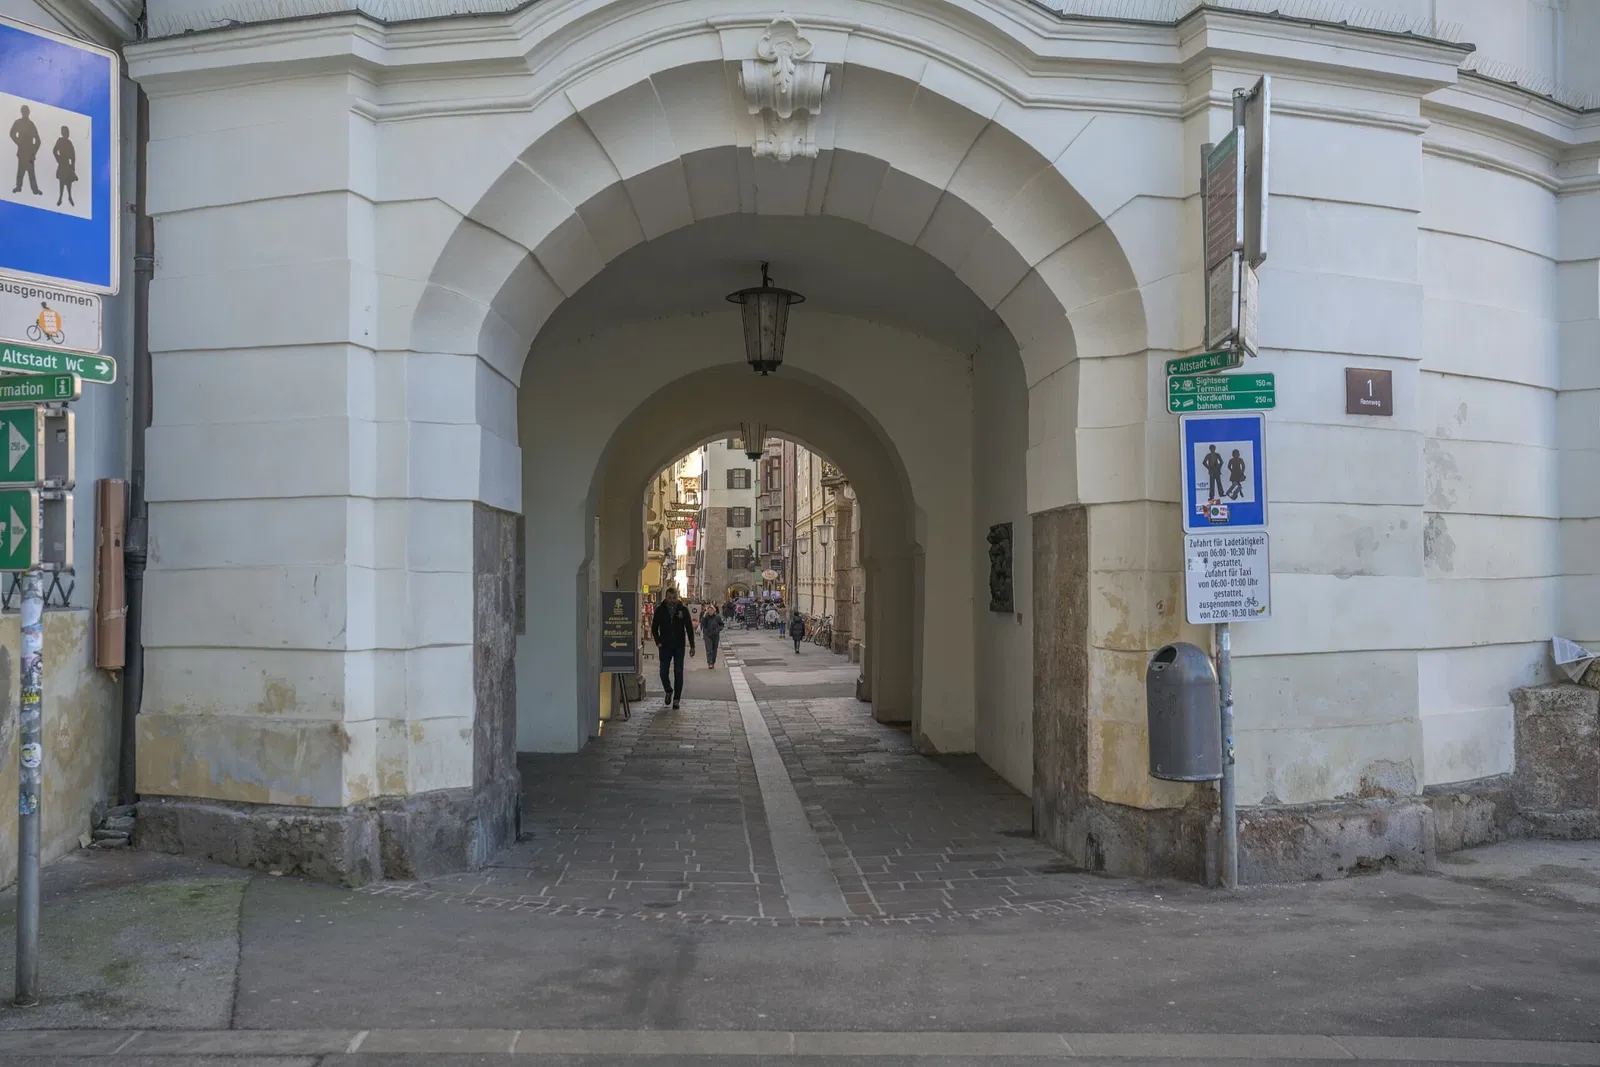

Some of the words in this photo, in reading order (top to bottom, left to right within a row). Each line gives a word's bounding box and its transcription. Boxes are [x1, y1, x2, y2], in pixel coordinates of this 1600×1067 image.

[0, 282, 93, 307] ausgenommen
[2, 349, 58, 368] Altstadt
[66, 357, 84, 372] WC
[1196, 377, 1229, 385] Sightseer
[1367, 379, 1372, 396] 1
[11, 442, 20, 451] 250
[1190, 539, 1212, 547] Zufahrt
[1214, 538, 1222, 546] für
[1225, 536, 1264, 547] Ladetätigkeit
[1213, 559, 1242, 568] gestattet,
[1205, 569, 1227, 578] Zufahrt
[1240, 568, 1251, 576] Taxi
[1214, 590, 1243, 599] gestattet,
[1199, 600, 1242, 610] ausgenommen
